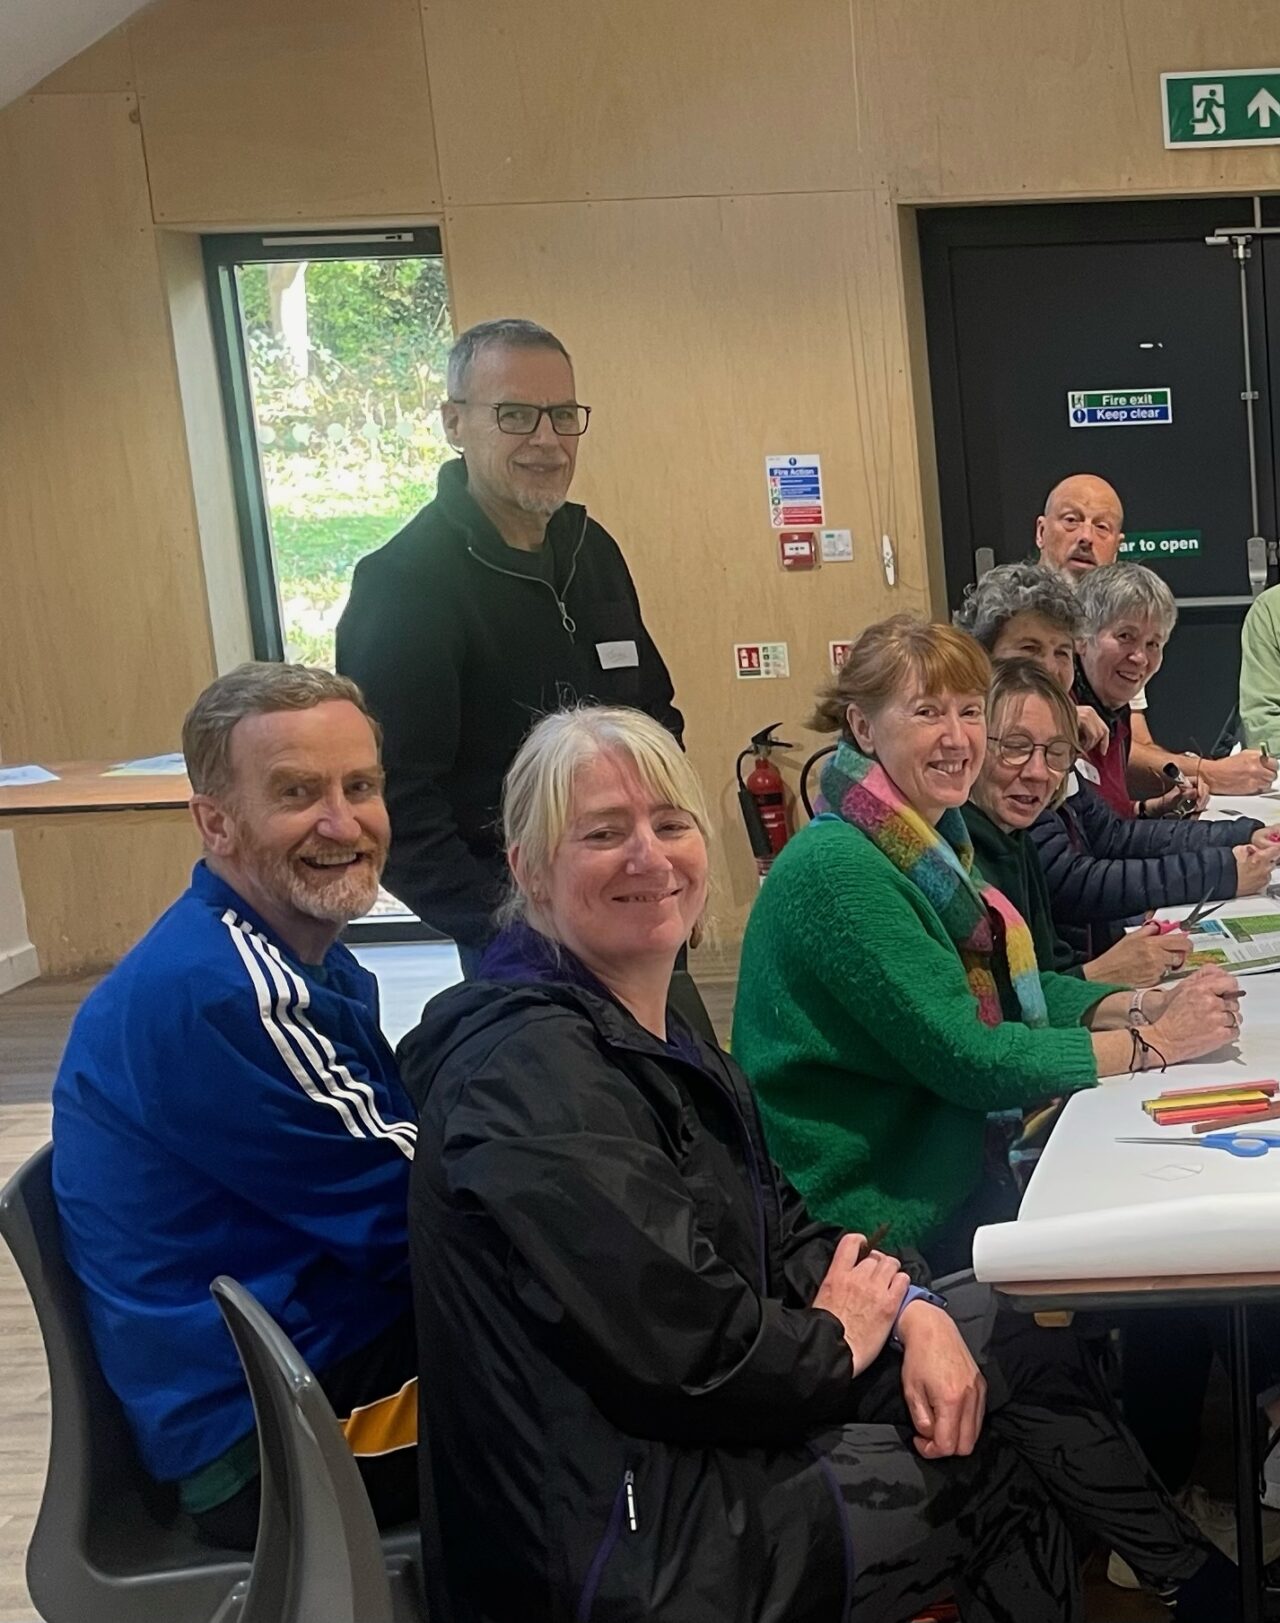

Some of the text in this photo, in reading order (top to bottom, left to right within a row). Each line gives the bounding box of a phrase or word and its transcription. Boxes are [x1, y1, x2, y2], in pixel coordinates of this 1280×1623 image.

[1102, 393, 1153, 406] Fire exit
[1096, 408, 1160, 421] Keep clear
[1119, 538, 1199, 553] ar to open
